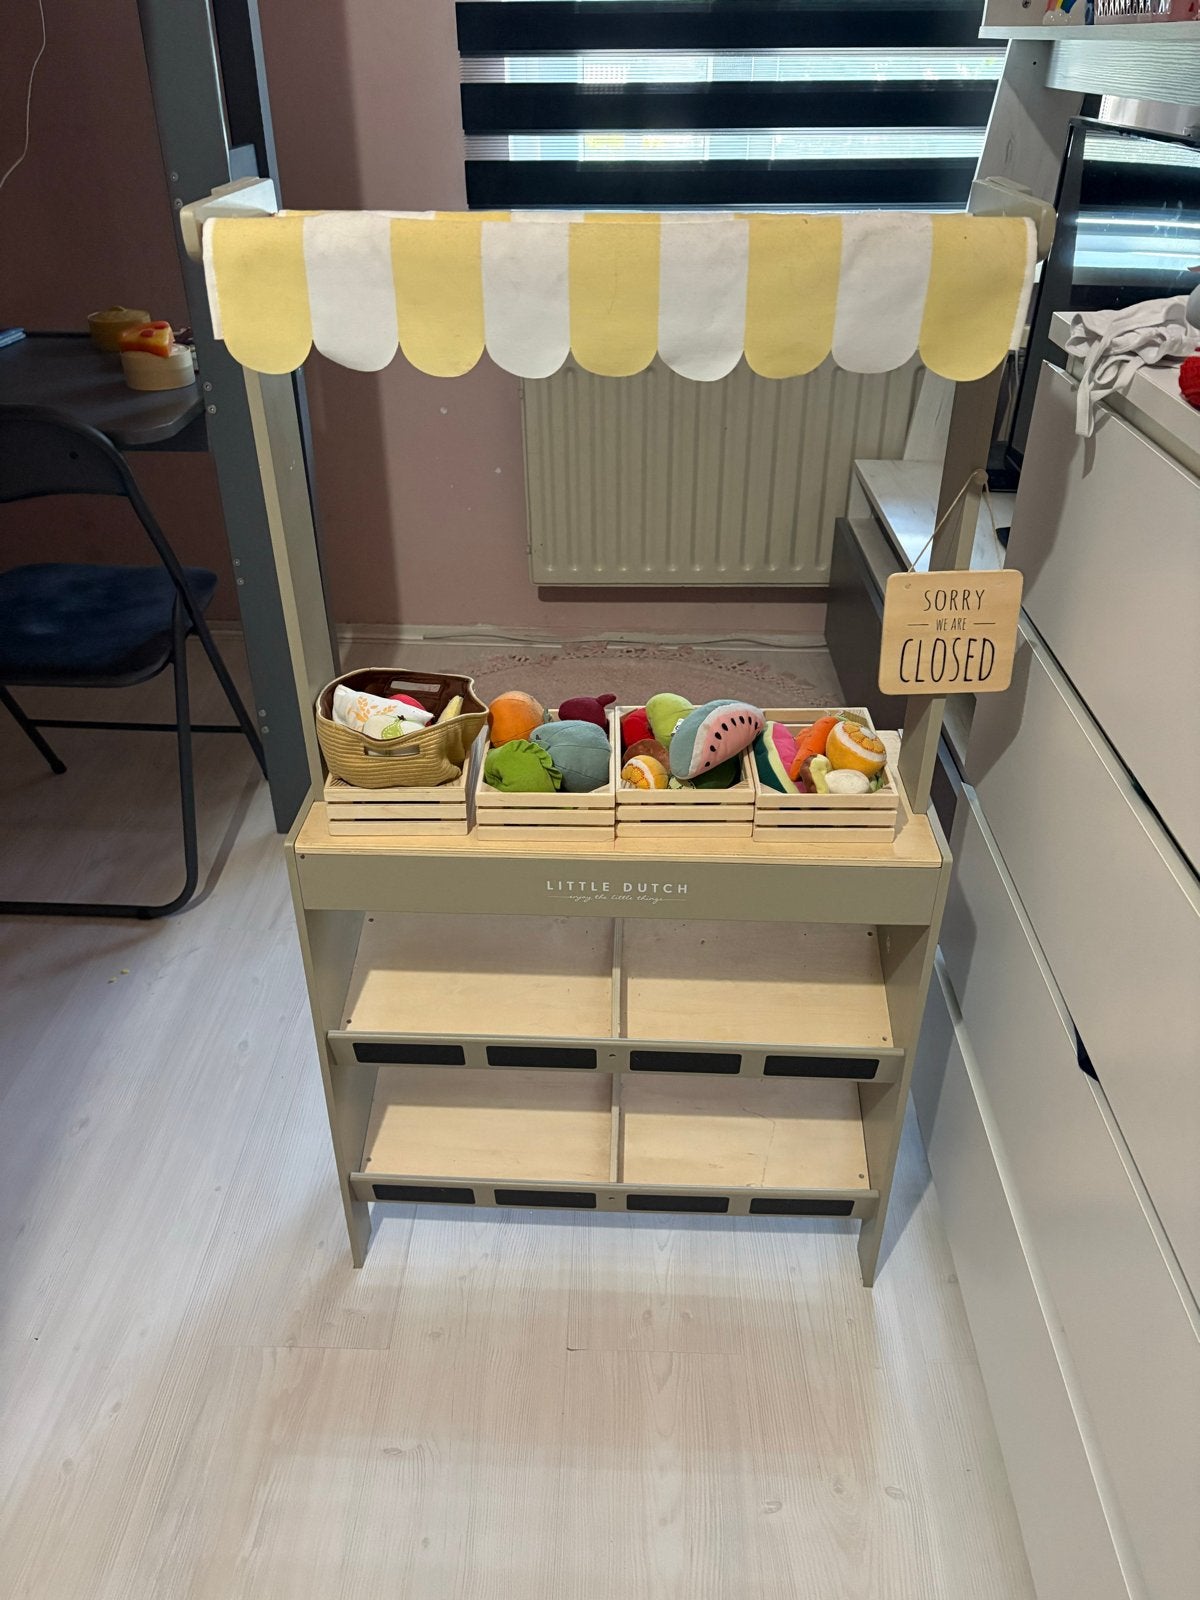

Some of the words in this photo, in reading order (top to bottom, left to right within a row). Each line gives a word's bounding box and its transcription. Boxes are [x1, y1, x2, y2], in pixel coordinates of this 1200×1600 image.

[924, 589, 985, 611] SORRY
[936, 618, 948, 631] WE
[950, 618, 967, 631] ARE
[899, 637, 996, 683] CLOSED
[546, 880, 610, 892] LITTLE
[623, 882, 689, 894] DUTCH
[569, 895, 592, 903] enjoy
[636, 895, 663, 904] things
